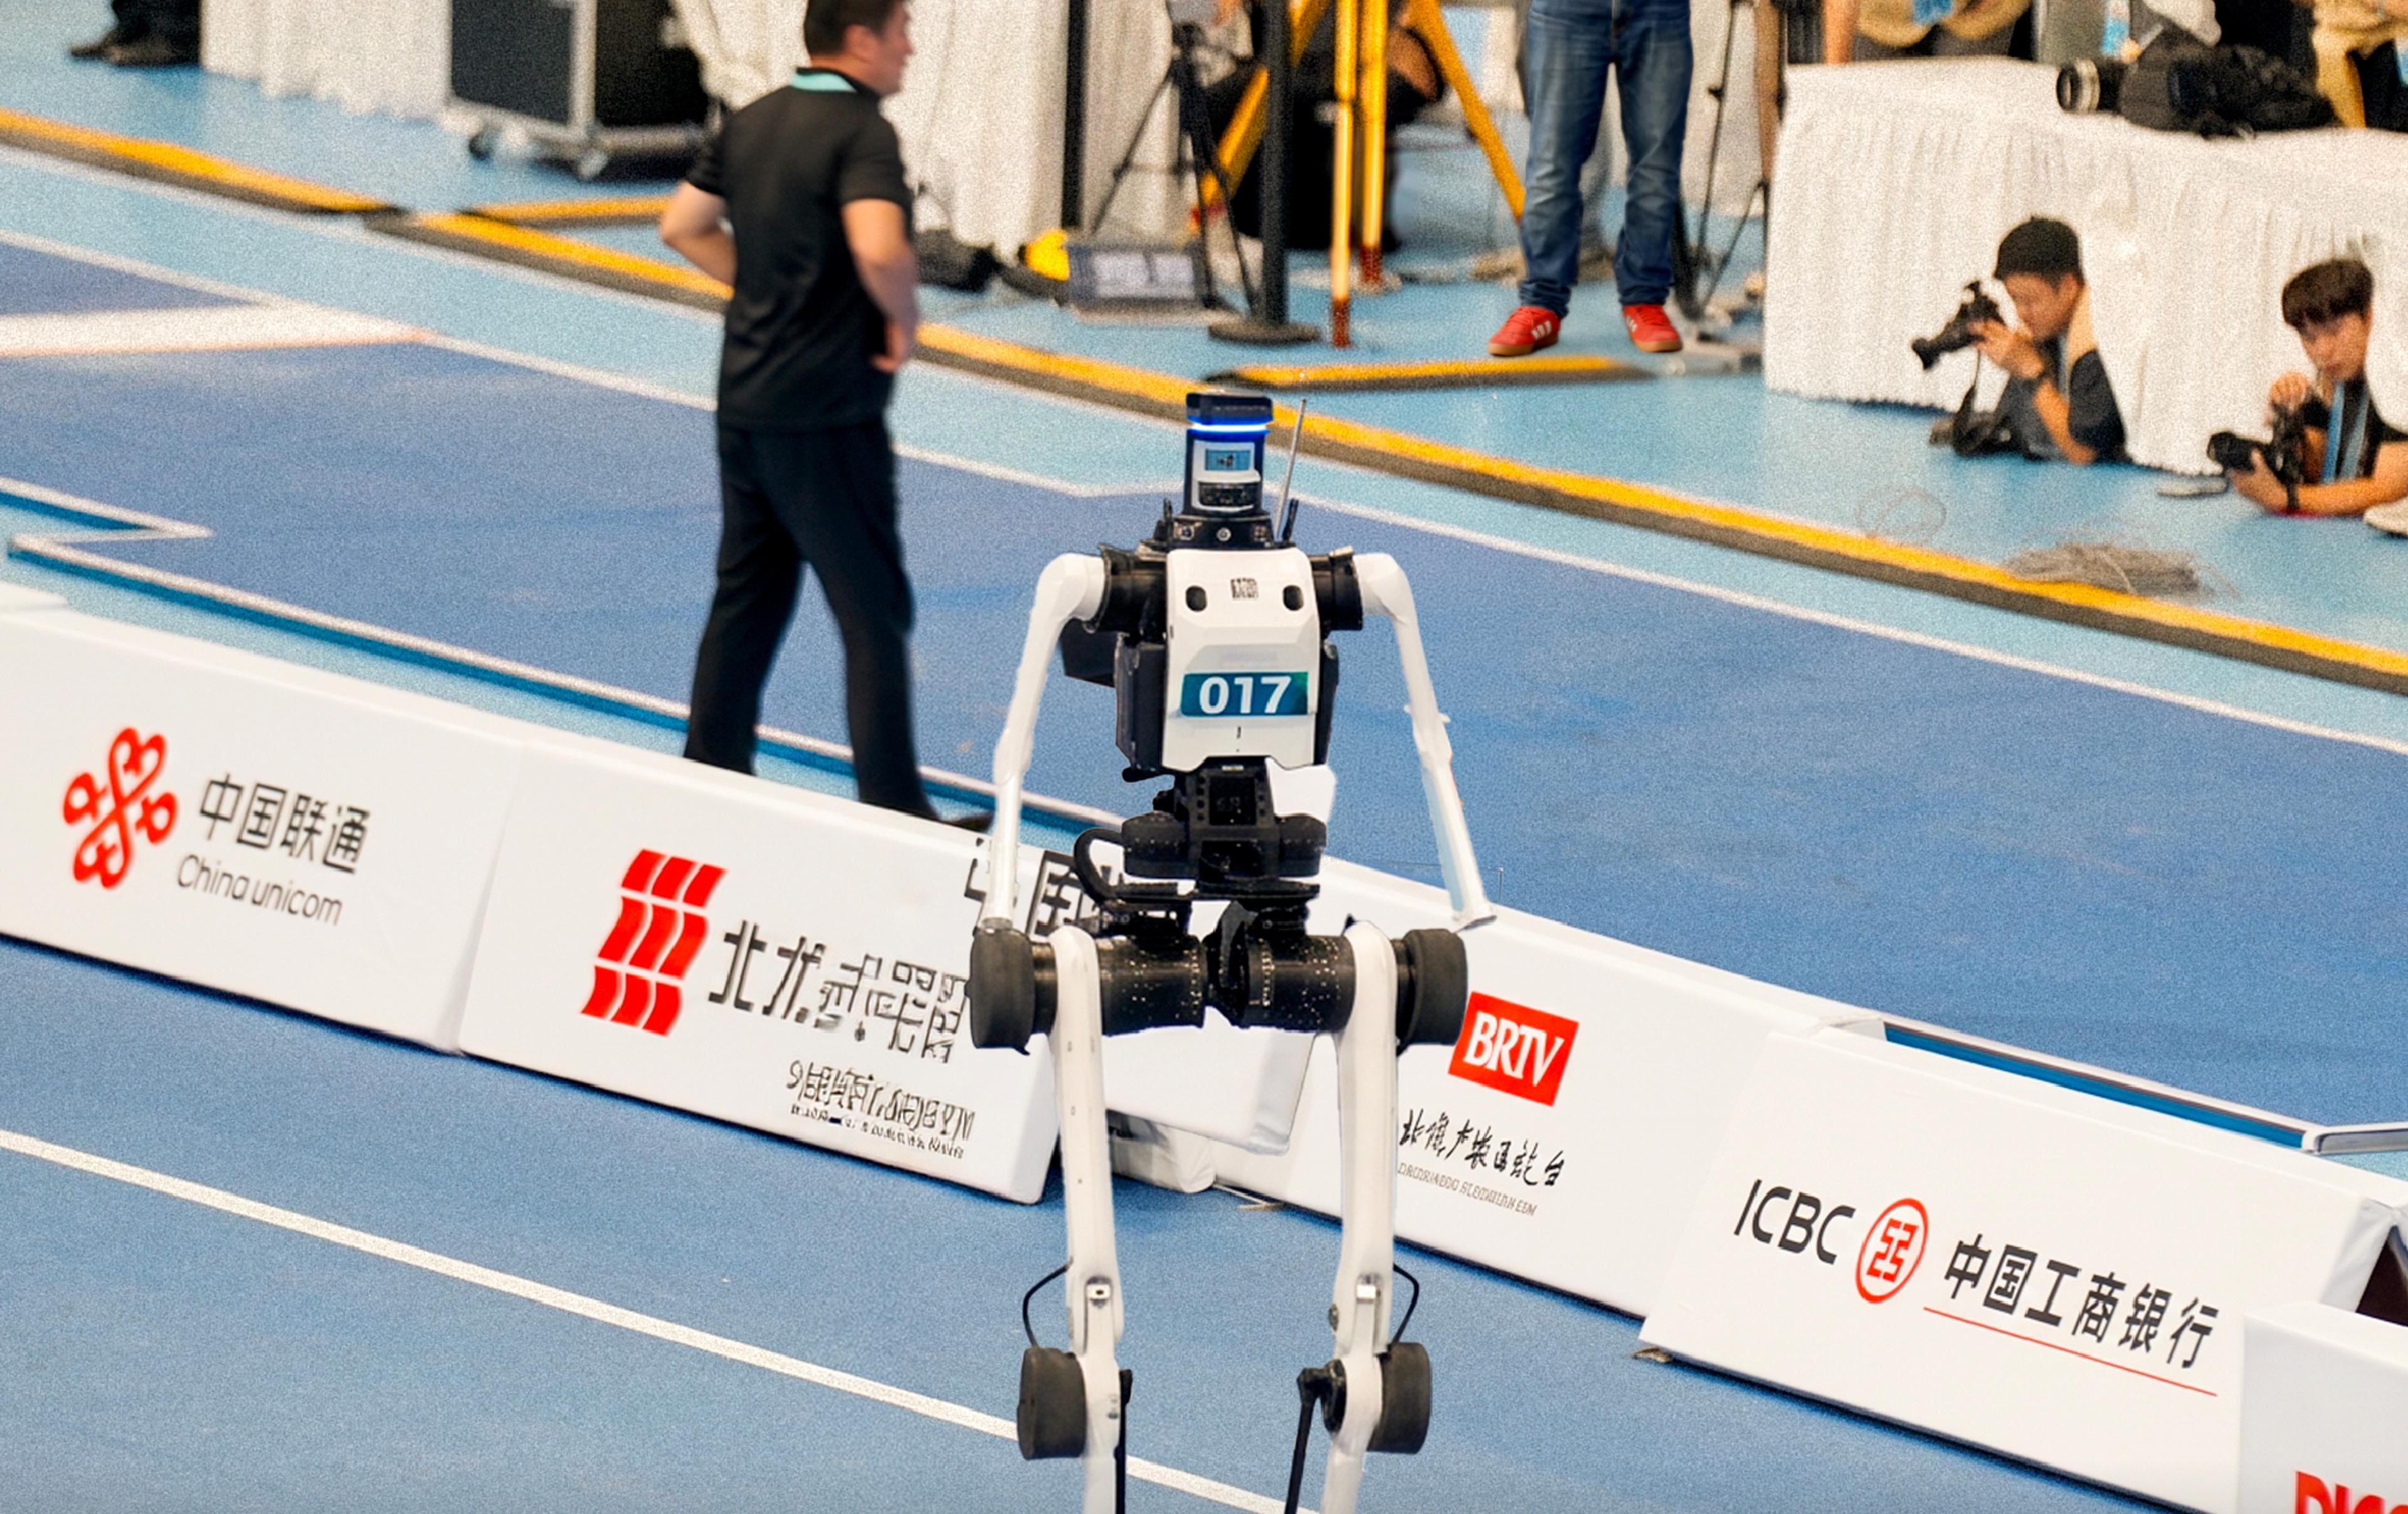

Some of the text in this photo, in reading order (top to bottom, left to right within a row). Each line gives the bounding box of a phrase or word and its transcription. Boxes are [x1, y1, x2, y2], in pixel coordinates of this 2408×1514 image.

[1198, 676, 1292, 715] 017
[199, 772, 371, 875] 中国联通
[177, 853, 343, 927] China unicom
[1463, 1011, 1565, 1088] BRTV
[1734, 1179, 1856, 1265] ICBC
[1943, 1233, 2219, 1369] 中国工商银行
